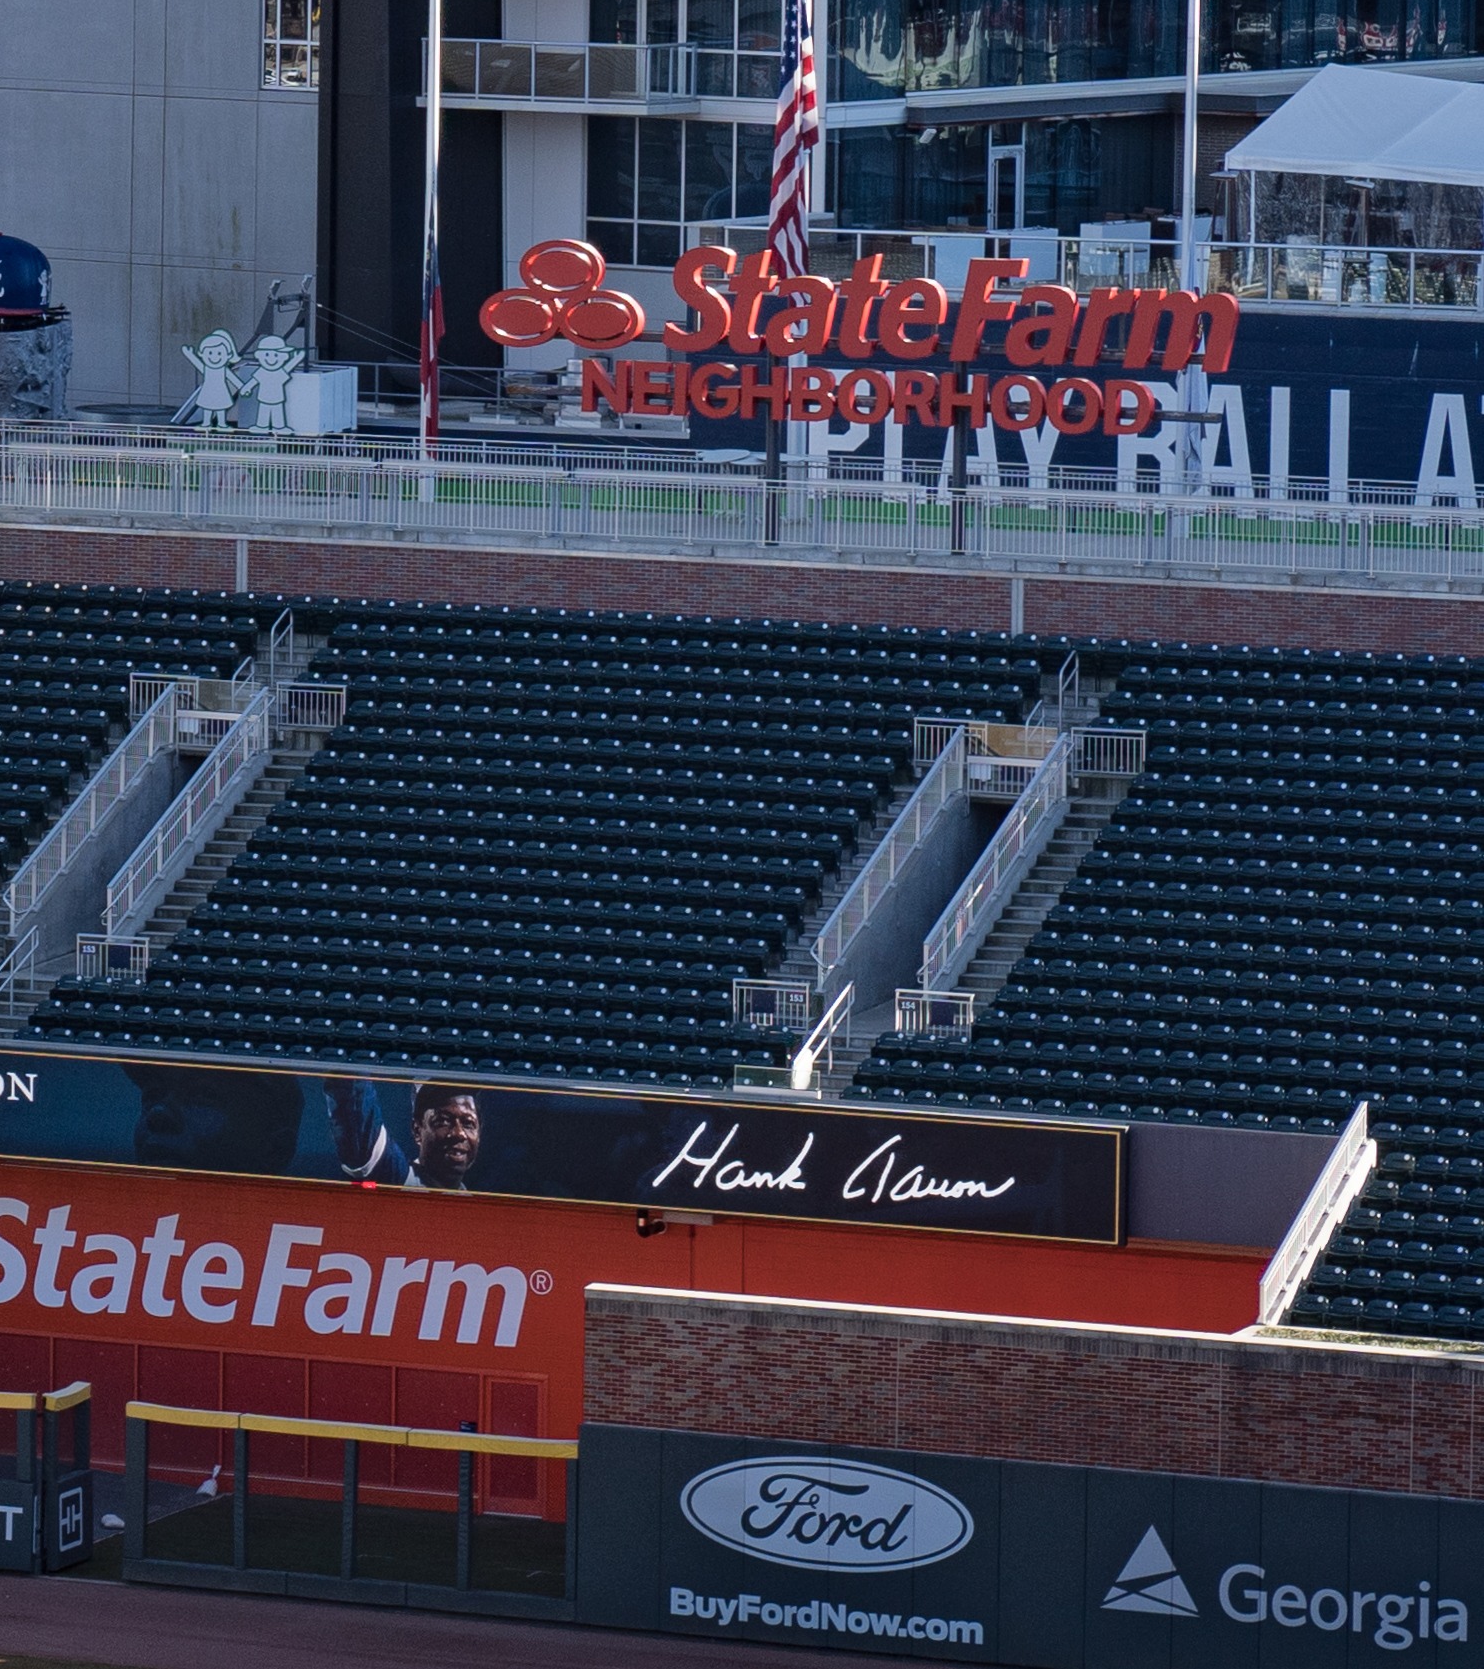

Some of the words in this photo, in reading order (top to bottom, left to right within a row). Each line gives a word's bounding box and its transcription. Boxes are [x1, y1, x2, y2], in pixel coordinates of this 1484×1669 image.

[579, 359, 1159, 437] NEIGHBORHOOD
[652, 1120, 813, 1191] Hank
[842, 1134, 1015, 1203] Aaron
[738, 1471, 913, 1554] Ford
[669, 1586, 984, 1645] BuyFordNow.com
[1218, 1562, 1470, 1650] Georgia
